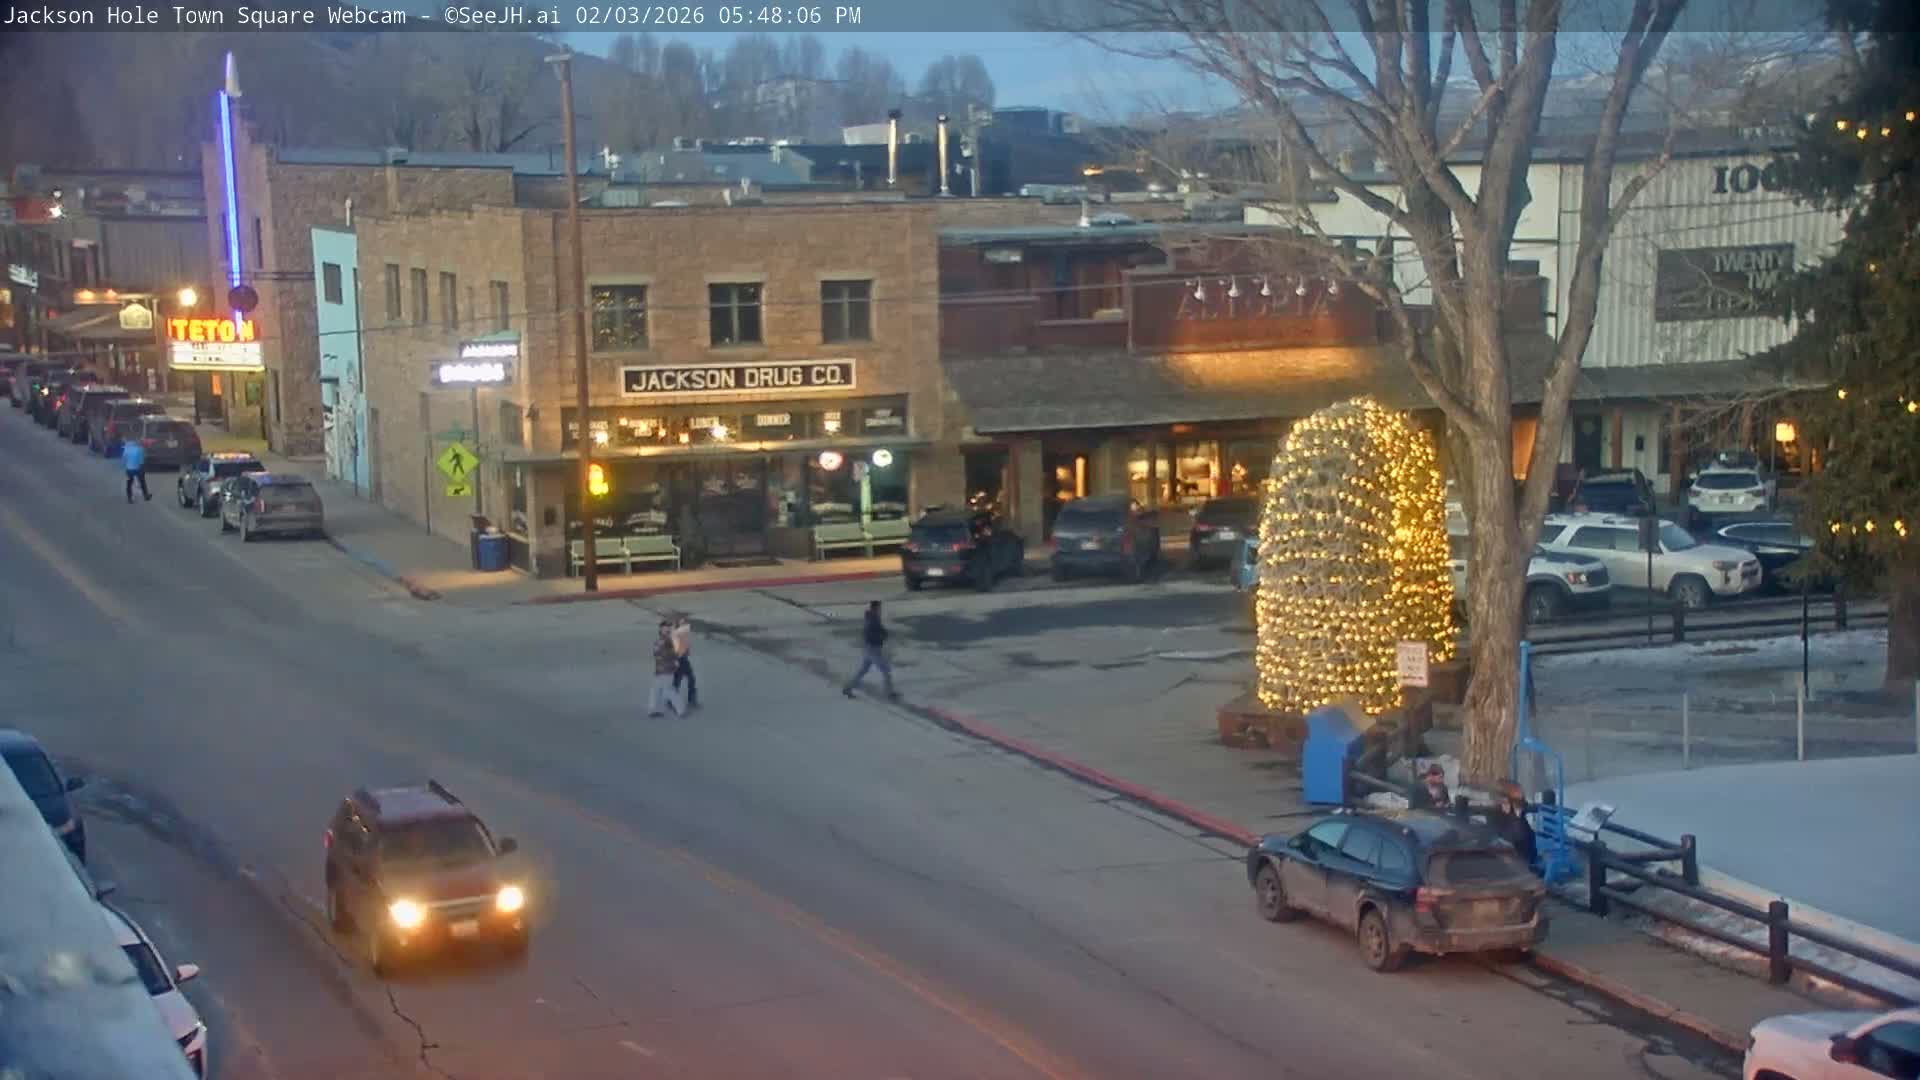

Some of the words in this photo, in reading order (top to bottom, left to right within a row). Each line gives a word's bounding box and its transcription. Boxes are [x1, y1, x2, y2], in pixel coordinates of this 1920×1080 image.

[1714, 251, 1784, 272] TWENTY
[171, 319, 255, 342] TETON
[631, 368, 736, 392] JACKSON
[744, 366, 803, 388] DRUG
[811, 365, 846, 385] CO.
